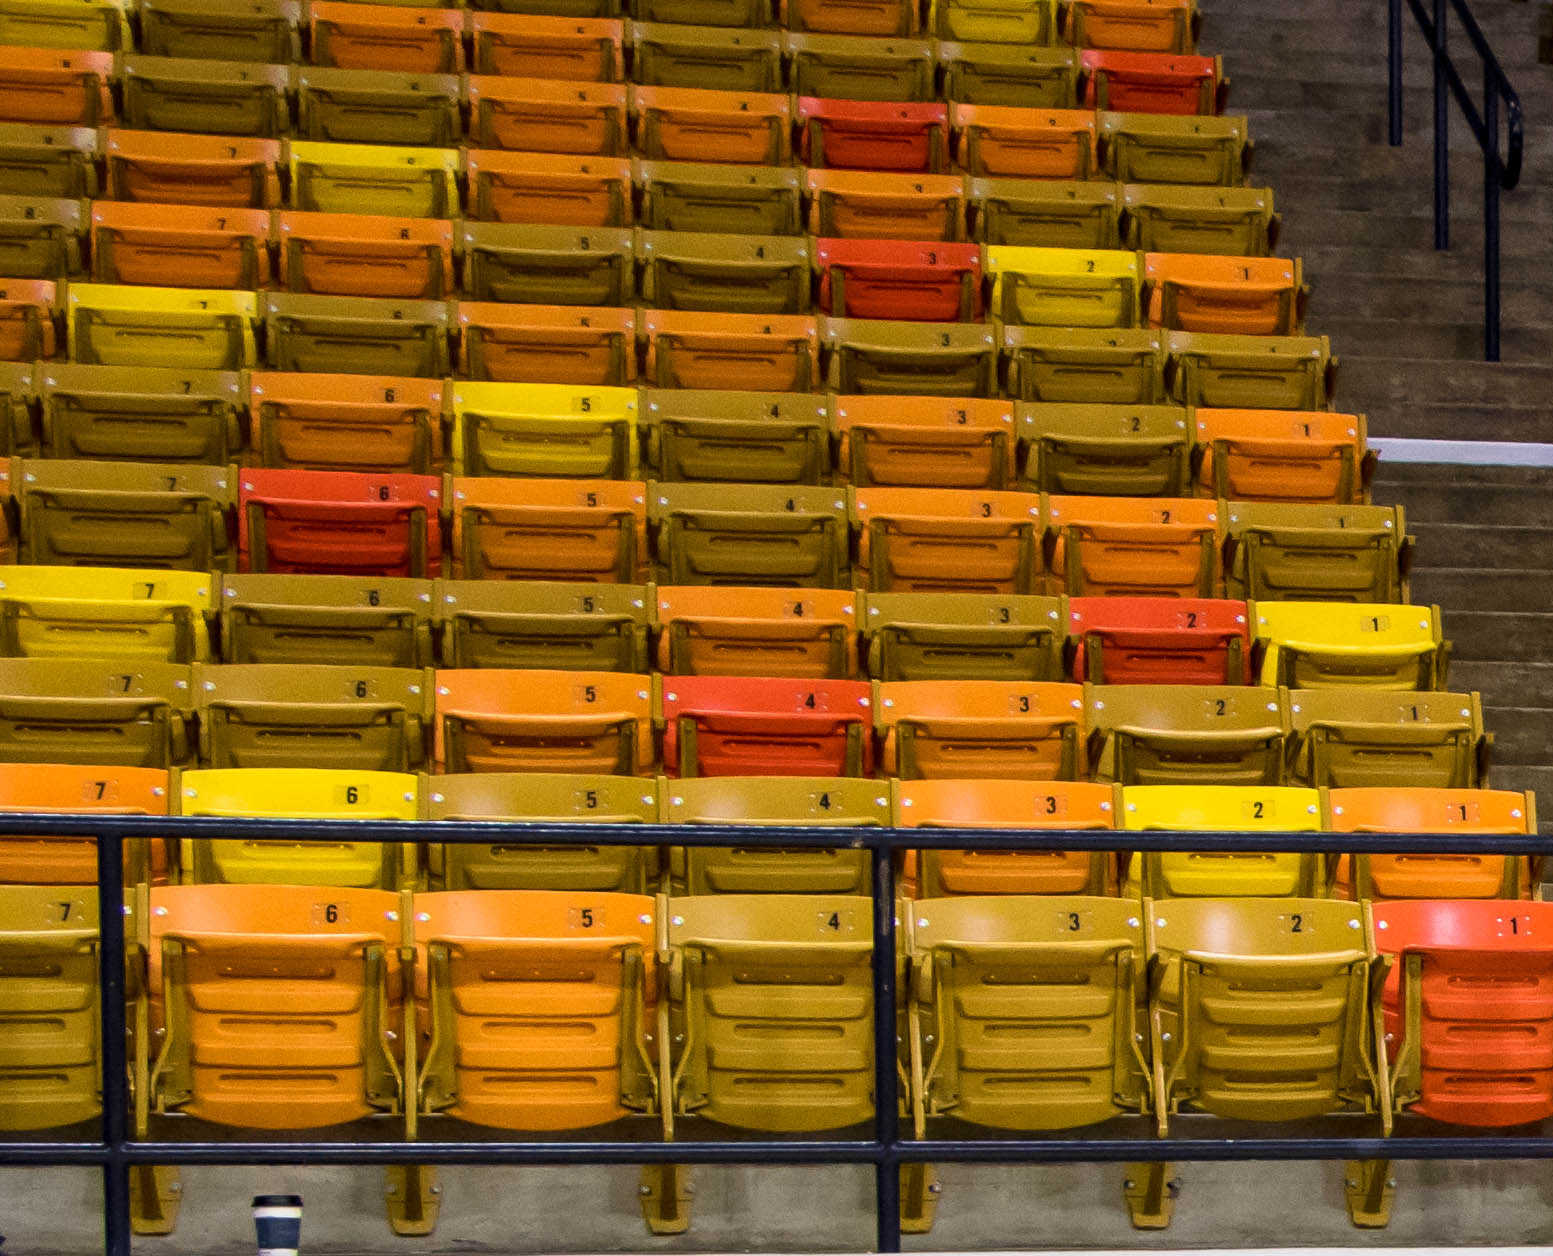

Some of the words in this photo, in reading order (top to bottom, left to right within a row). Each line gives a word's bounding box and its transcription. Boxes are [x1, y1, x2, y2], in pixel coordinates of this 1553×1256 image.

[182, 380, 192, 394] 7
[384, 388, 395, 404] 6
[581, 397, 591, 413] 5
[770, 404, 780, 419] 4
[957, 409, 967, 425] 3
[1131, 416, 1141, 433] 2
[1303, 423, 1310, 437] 1
[166, 476, 177, 492] 7
[378, 485, 390, 502] 6
[586, 492, 597, 507] 5
[785, 498, 795, 512] 4
[982, 502, 992, 518] 3
[1161, 510, 1171, 525] 2
[1338, 517, 1345, 529] 1
[144, 582, 155, 599] 7
[368, 589, 380, 607] 6
[583, 596, 594, 613] 5
[792, 602, 804, 617] 4
[999, 607, 1010, 624] 3
[1187, 612, 1197, 629] 2
[1371, 617, 1379, 632] 1
[121, 675, 133, 693] 7
[355, 680, 367, 698] 6
[585, 685, 596, 703] 5
[805, 693, 817, 710] 4
[1019, 695, 1030, 713] 3
[1215, 699, 1226, 717] 2
[1410, 705, 1418, 721] 1
[95, 781, 107, 800] 7
[346, 786, 358, 805] 6
[586, 790, 598, 809] 5
[819, 793, 832, 811] 4
[1046, 796, 1057, 815] 3
[1253, 801, 1264, 819] 2
[1459, 805, 1467, 821] 1
[59, 902, 72, 922] 7
[325, 904, 338, 924] 6
[581, 908, 593, 928] 5
[827, 912, 841, 931] 4
[1068, 912, 1081, 932] 3
[1291, 914, 1302, 933] 2
[1510, 917, 1518, 935] 1
